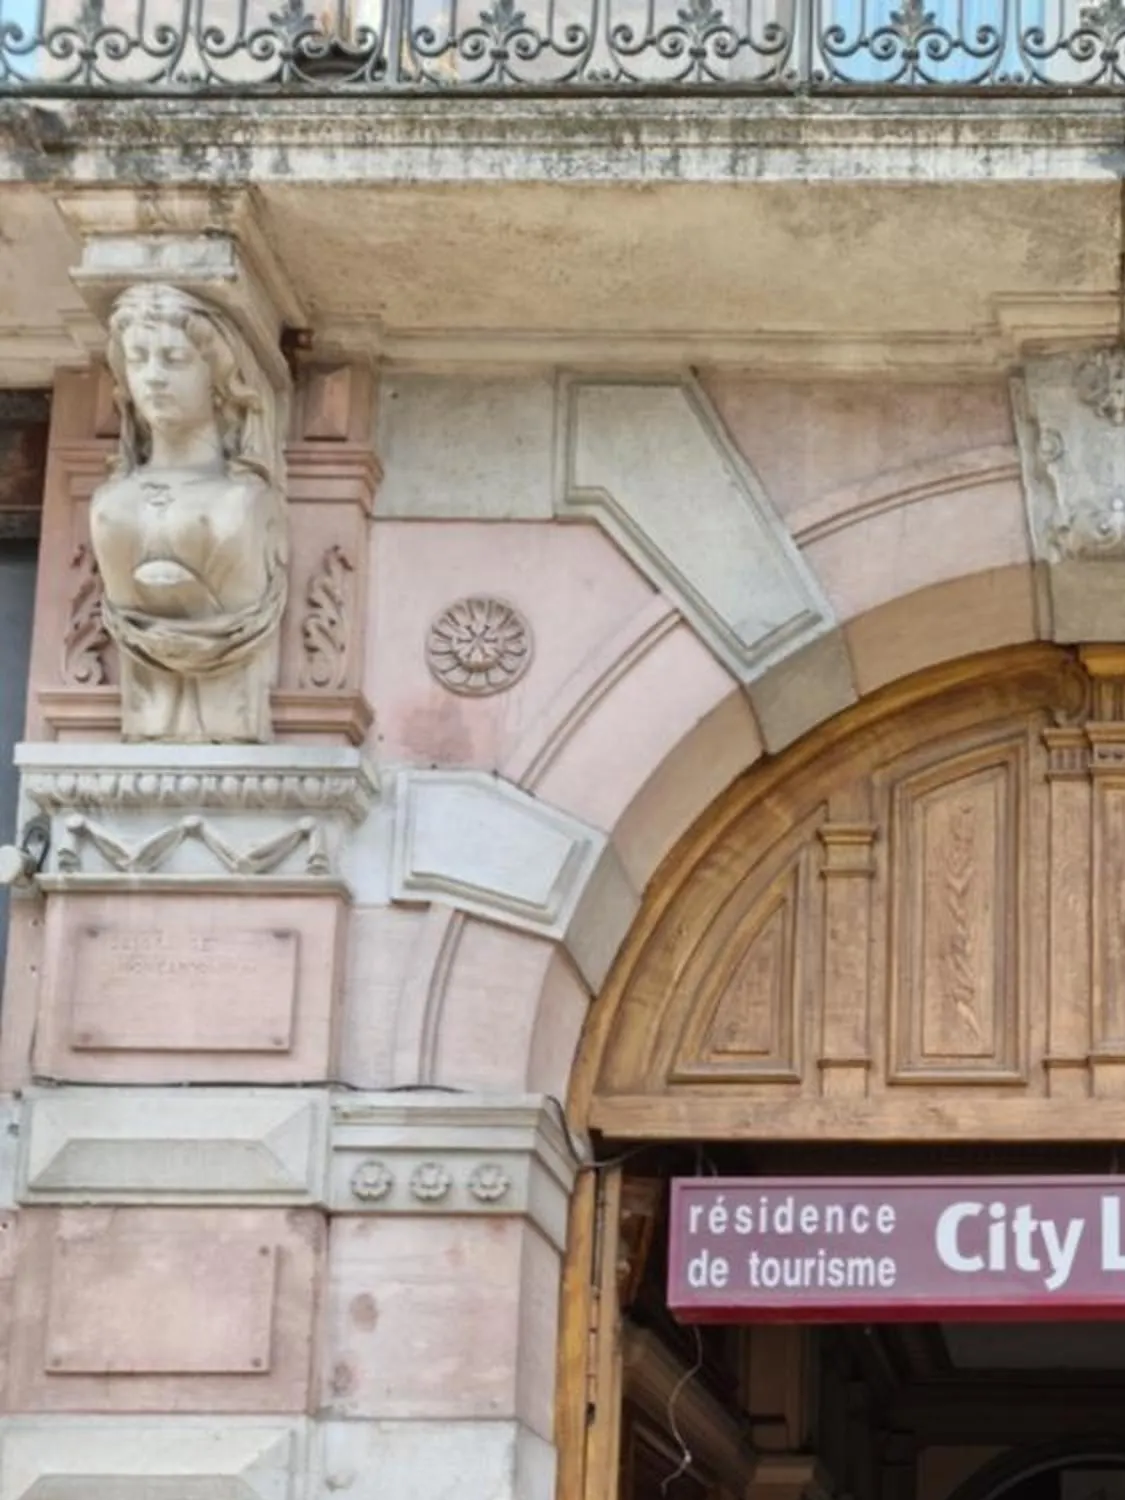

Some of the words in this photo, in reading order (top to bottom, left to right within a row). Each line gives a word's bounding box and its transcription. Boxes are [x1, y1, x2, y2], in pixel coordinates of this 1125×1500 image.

[689, 1196, 897, 1234] résidence
[935, 1202, 1085, 1292] City
[688, 1249, 729, 1288] de
[749, 1249, 897, 1288] tourisme
